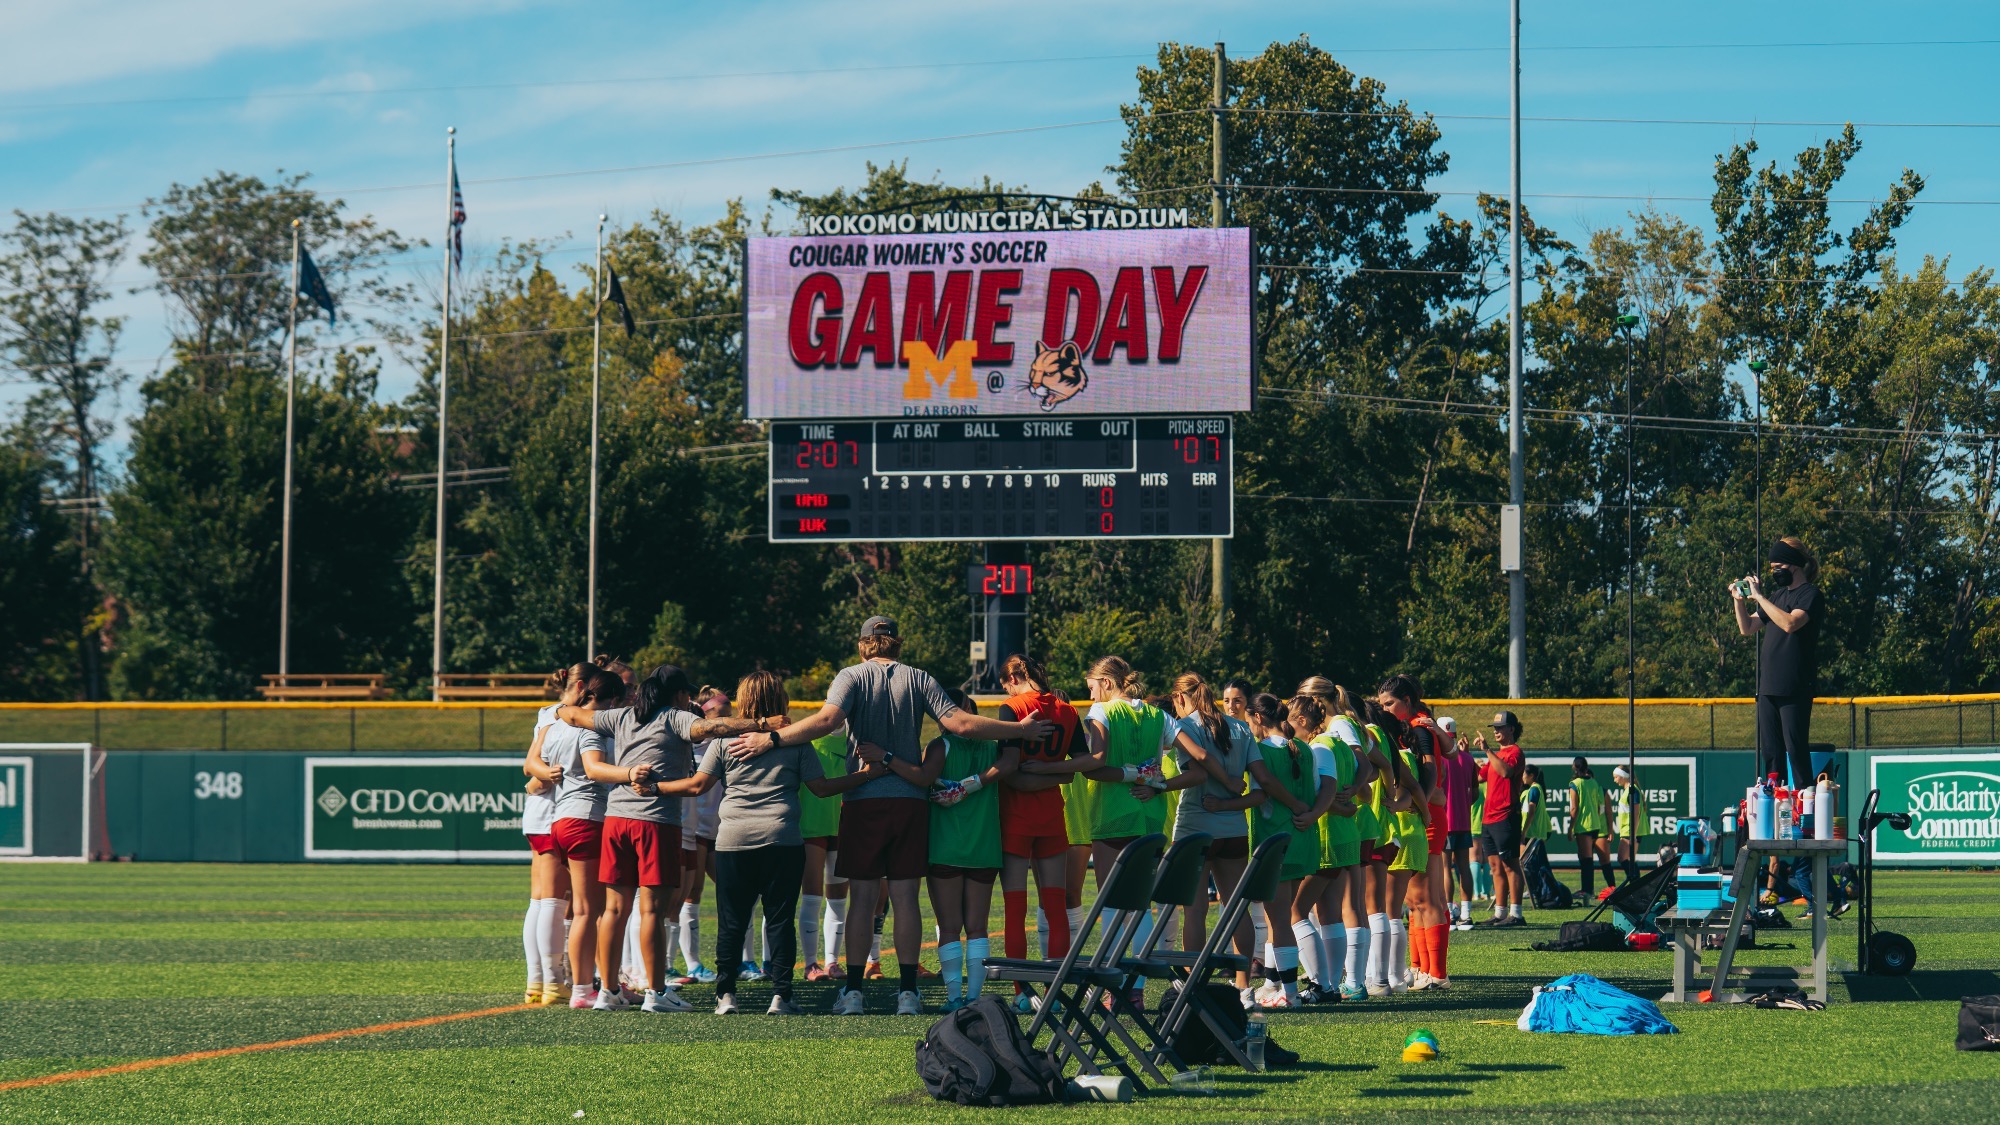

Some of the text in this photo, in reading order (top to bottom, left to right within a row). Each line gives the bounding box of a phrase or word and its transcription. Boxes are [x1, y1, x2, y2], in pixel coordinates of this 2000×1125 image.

[809, 207, 1189, 235] KOKOMO MUNICIPAL STADIUM
[789, 240, 1047, 267] COUGAR WOMEN'S SOCCER
[788, 265, 1210, 367] GAME DAY
[903, 340, 978, 399] M
[986, 371, 1004, 393] @
[903, 405, 978, 416] DEARBORN
[800, 425, 835, 440] TIME
[893, 423, 940, 439] AT BAT
[964, 423, 1000, 438] BALL
[1023, 422, 1073, 437] STRIKE
[1101, 421, 1130, 436] OUT
[1168, 420, 1225, 435] PITCH SPEED
[796, 441, 859, 469] 2:07
[862, 473, 1217, 490] 1 2 3 4 5 6 7 8 9 10 RUNS HITS ERR
[795, 493, 828, 508] UMD
[1101, 487, 1113, 508] 0
[799, 518, 827, 533] IUK
[1101, 512, 1113, 533] 0
[983, 564, 1032, 595] 2:07
[194, 771, 243, 799] 348
[350, 788, 527, 814] CFD COMPANI
[1907, 781, 2000, 819] Solidarity
[1903, 811, 2000, 840] Commu
[1921, 839, 1996, 848] FEDERAL CREDIT
